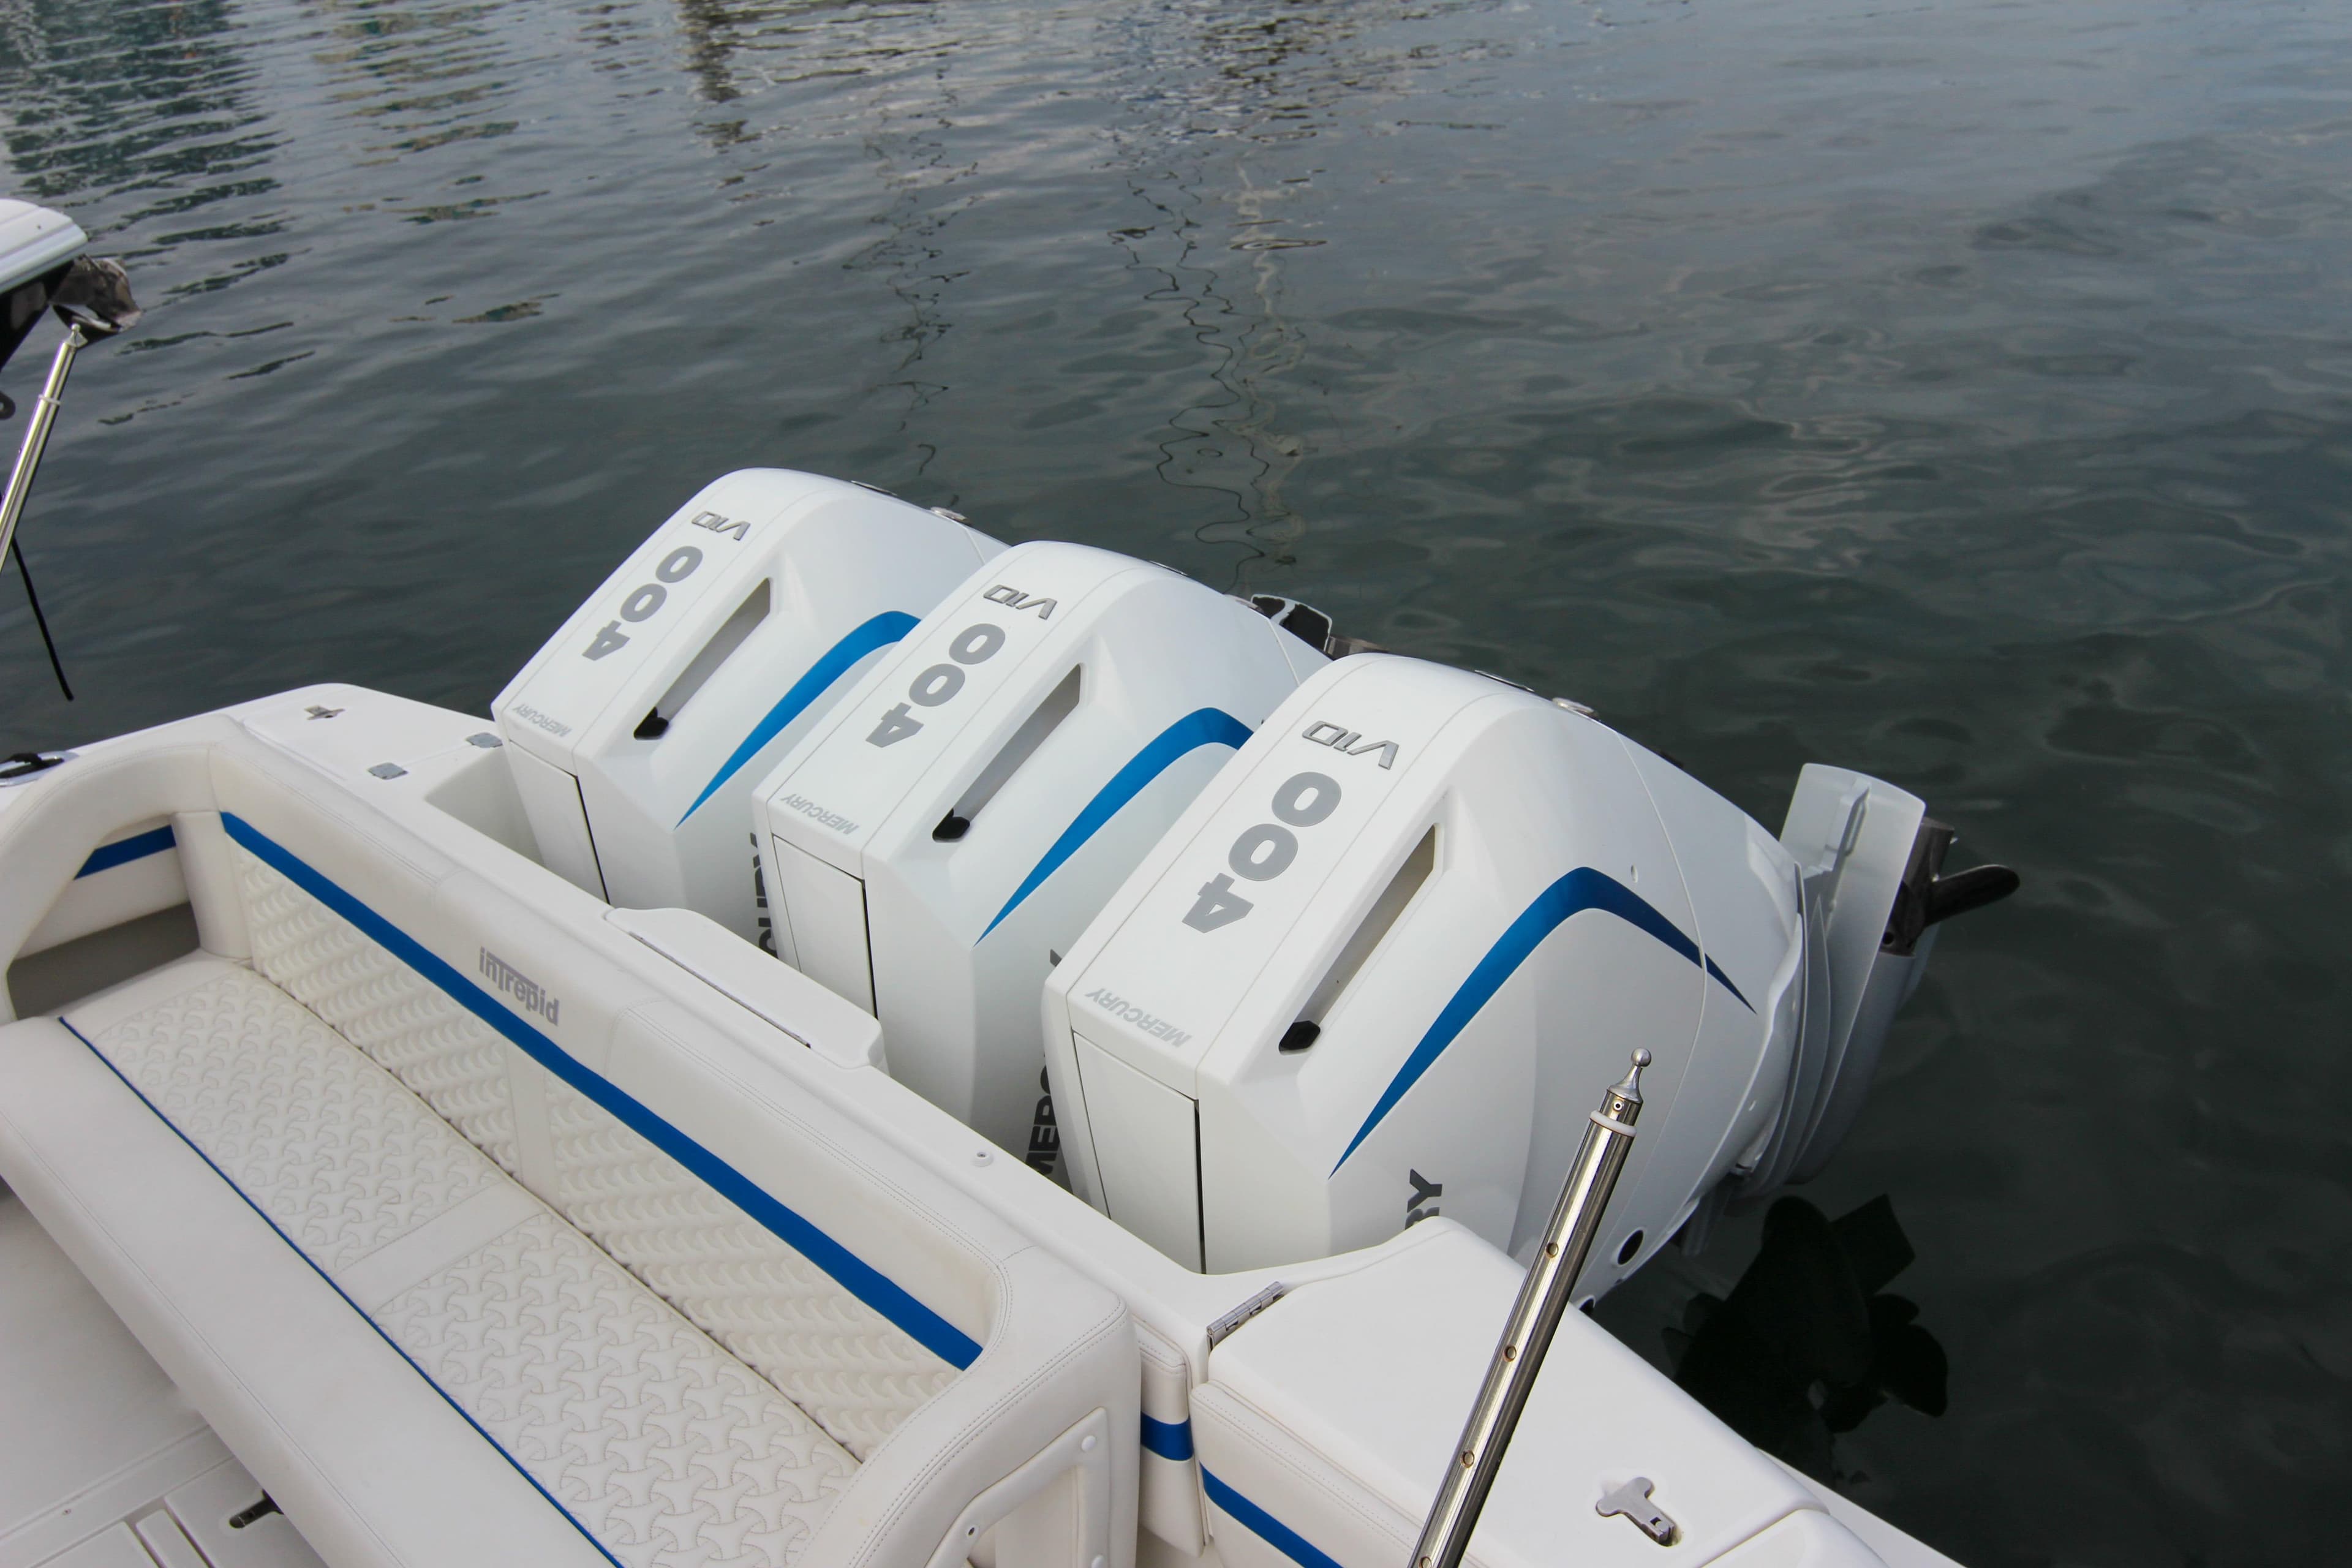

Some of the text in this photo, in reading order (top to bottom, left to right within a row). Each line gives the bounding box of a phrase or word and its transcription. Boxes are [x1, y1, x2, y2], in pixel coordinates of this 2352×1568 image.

[582, 546, 703, 661] 400
[513, 703, 572, 737] MERCURY
[865, 623, 1006, 748] 400
[780, 793, 860, 835] MERCURY
[1182, 771, 1342, 933] 400
[1085, 987, 1192, 1048] MERCURY
